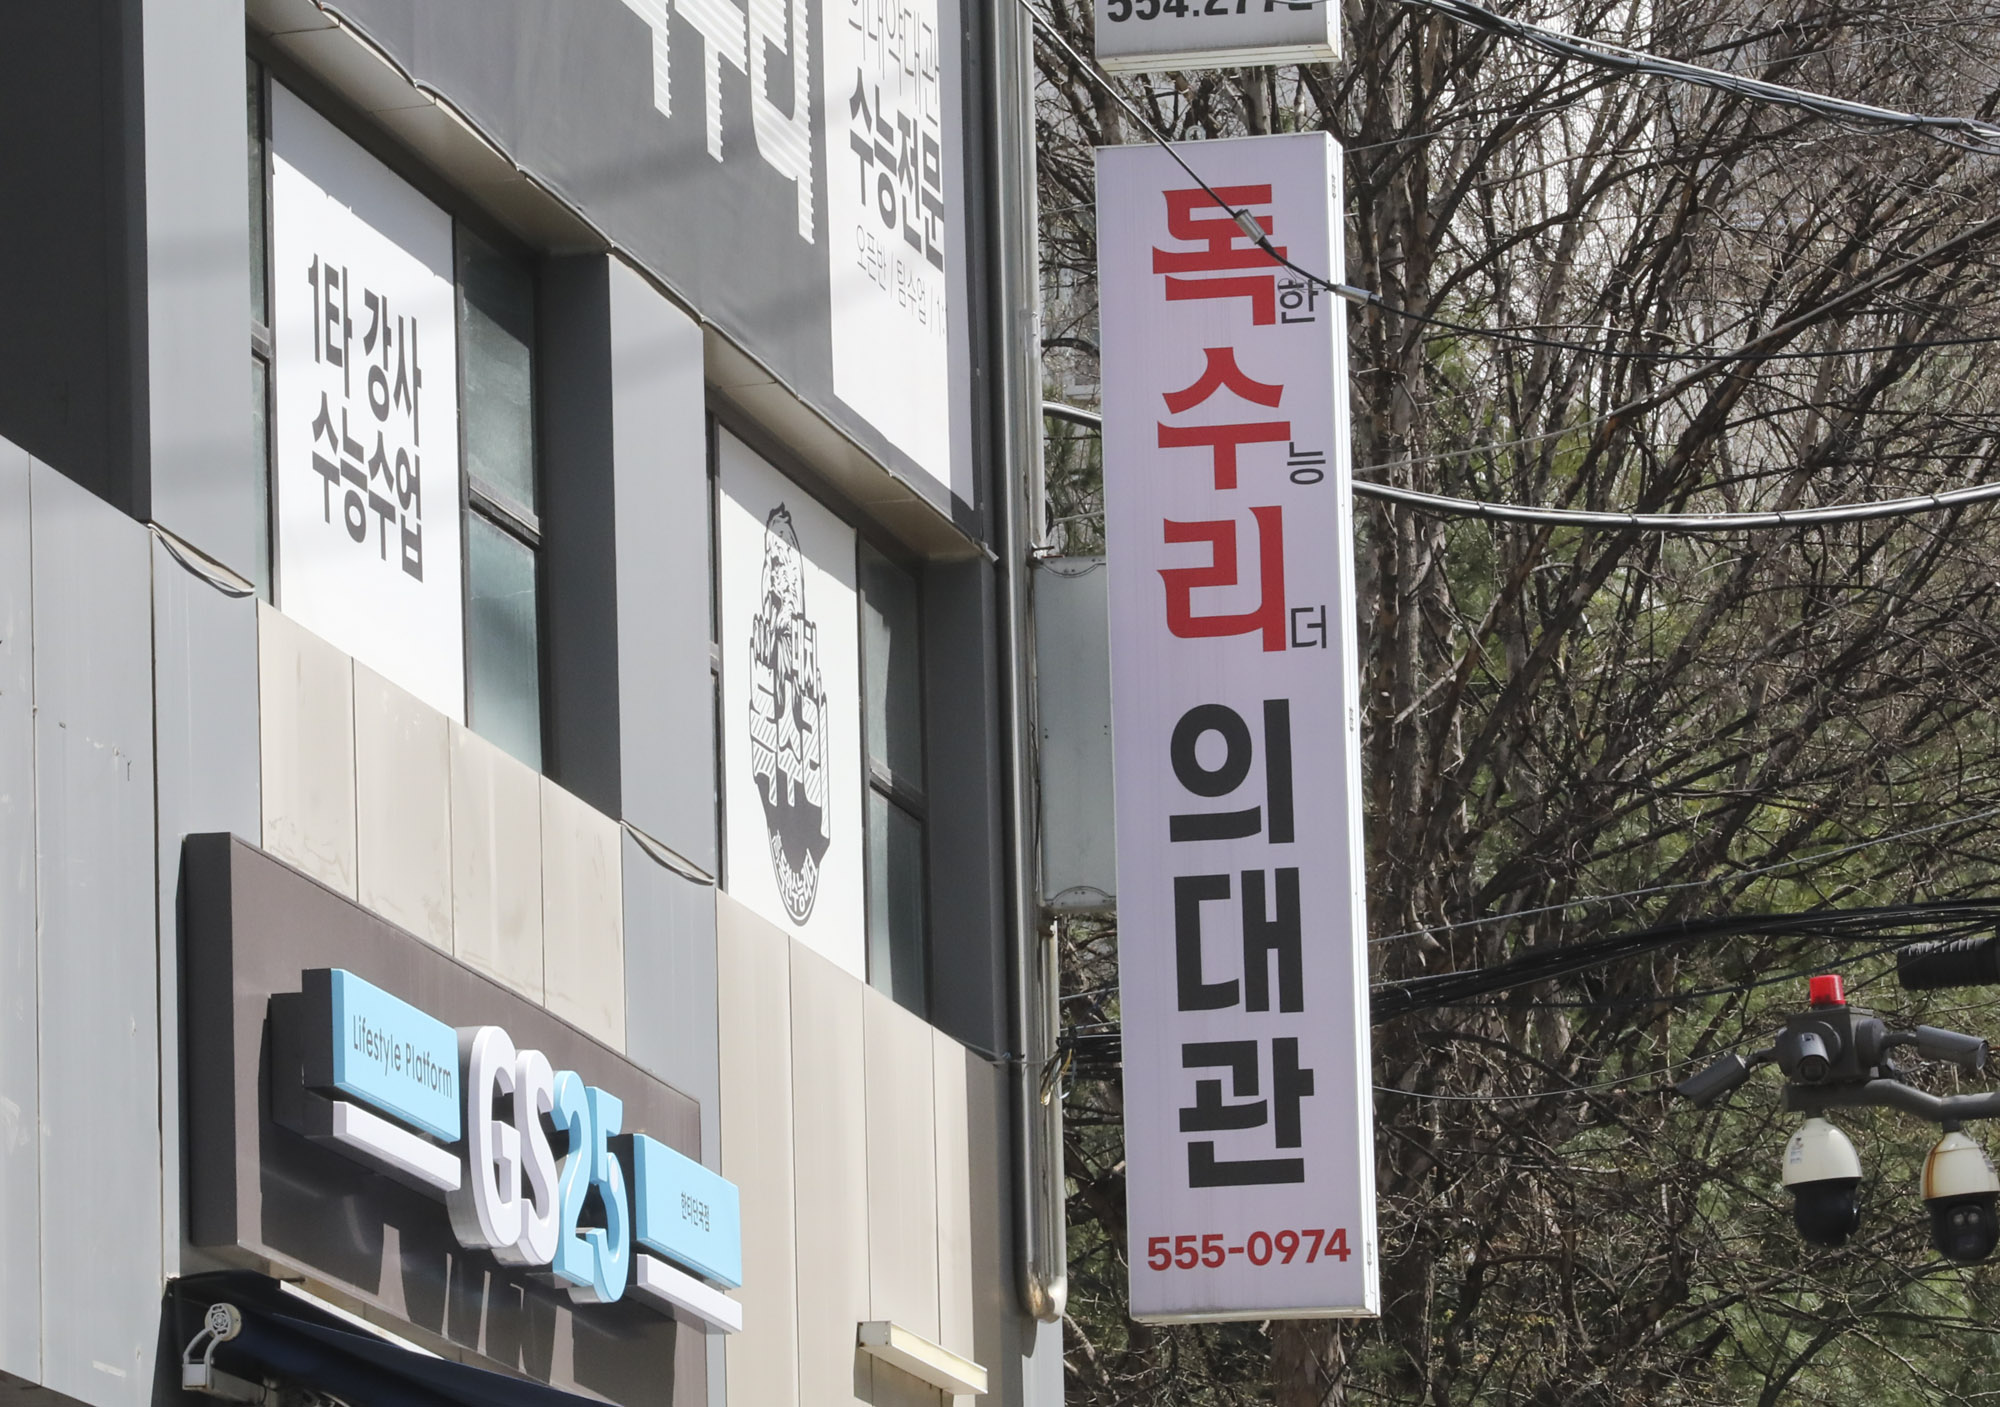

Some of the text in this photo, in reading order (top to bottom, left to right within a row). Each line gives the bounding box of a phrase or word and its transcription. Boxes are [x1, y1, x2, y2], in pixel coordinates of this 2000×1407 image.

[849, 66, 944, 273] 수능전문
[857, 224, 886, 291] 오픈반
[897, 259, 926, 325] 팀수업
[312, 390, 423, 583] 수능수업
[750, 645, 830, 839] 독수리
[791, 617, 818, 698] 대치
[1152, 184, 1314, 1188] 독수리 의대관
[353, 1015, 453, 1099] Lifestyle Platform
[468, 1026, 630, 1302] GS25
[1147, 1228, 1352, 1271] 555-0974
